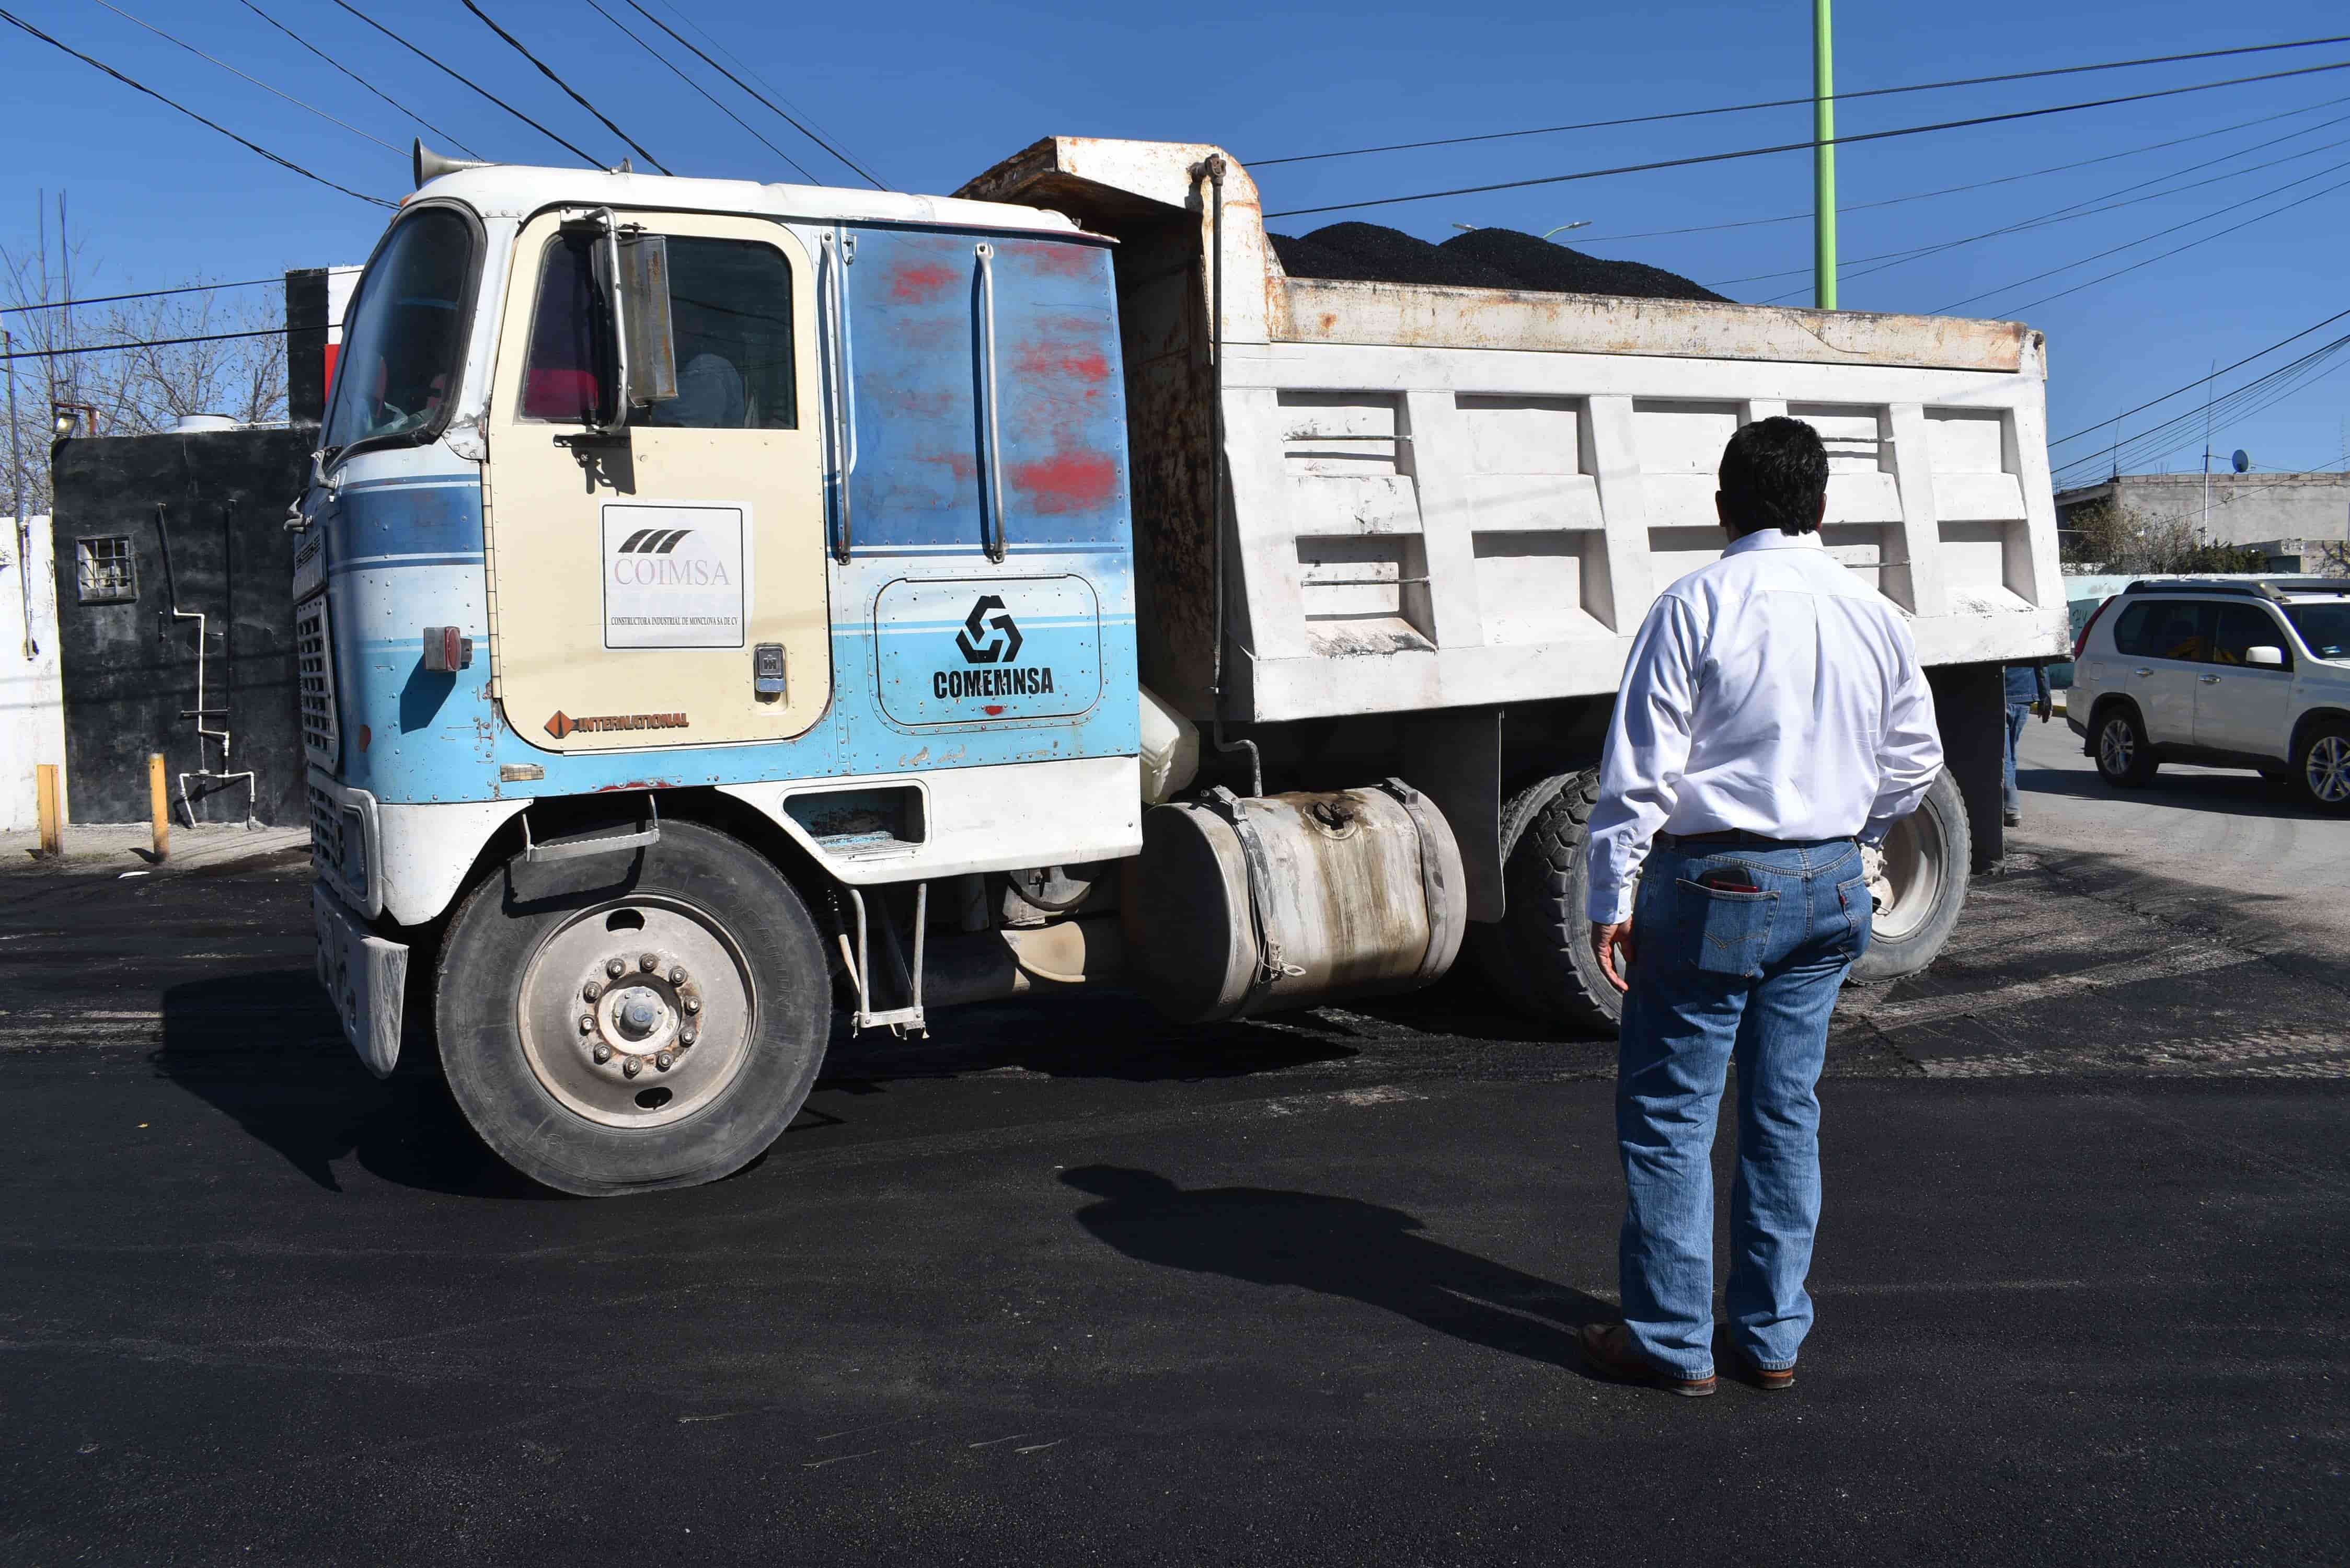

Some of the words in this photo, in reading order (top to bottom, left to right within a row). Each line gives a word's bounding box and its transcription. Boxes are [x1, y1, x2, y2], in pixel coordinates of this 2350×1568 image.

[614, 558, 732, 586] COIMSA
[610, 616, 651, 625] CONSTRUCTORA
[652, 616, 680, 625] INDUSTRIAL
[682, 616, 688, 625] DE
[689, 616, 716, 625] MONCLOVA
[724, 616, 731, 625] DE
[577, 713, 689, 732] INTERNATIONAL
